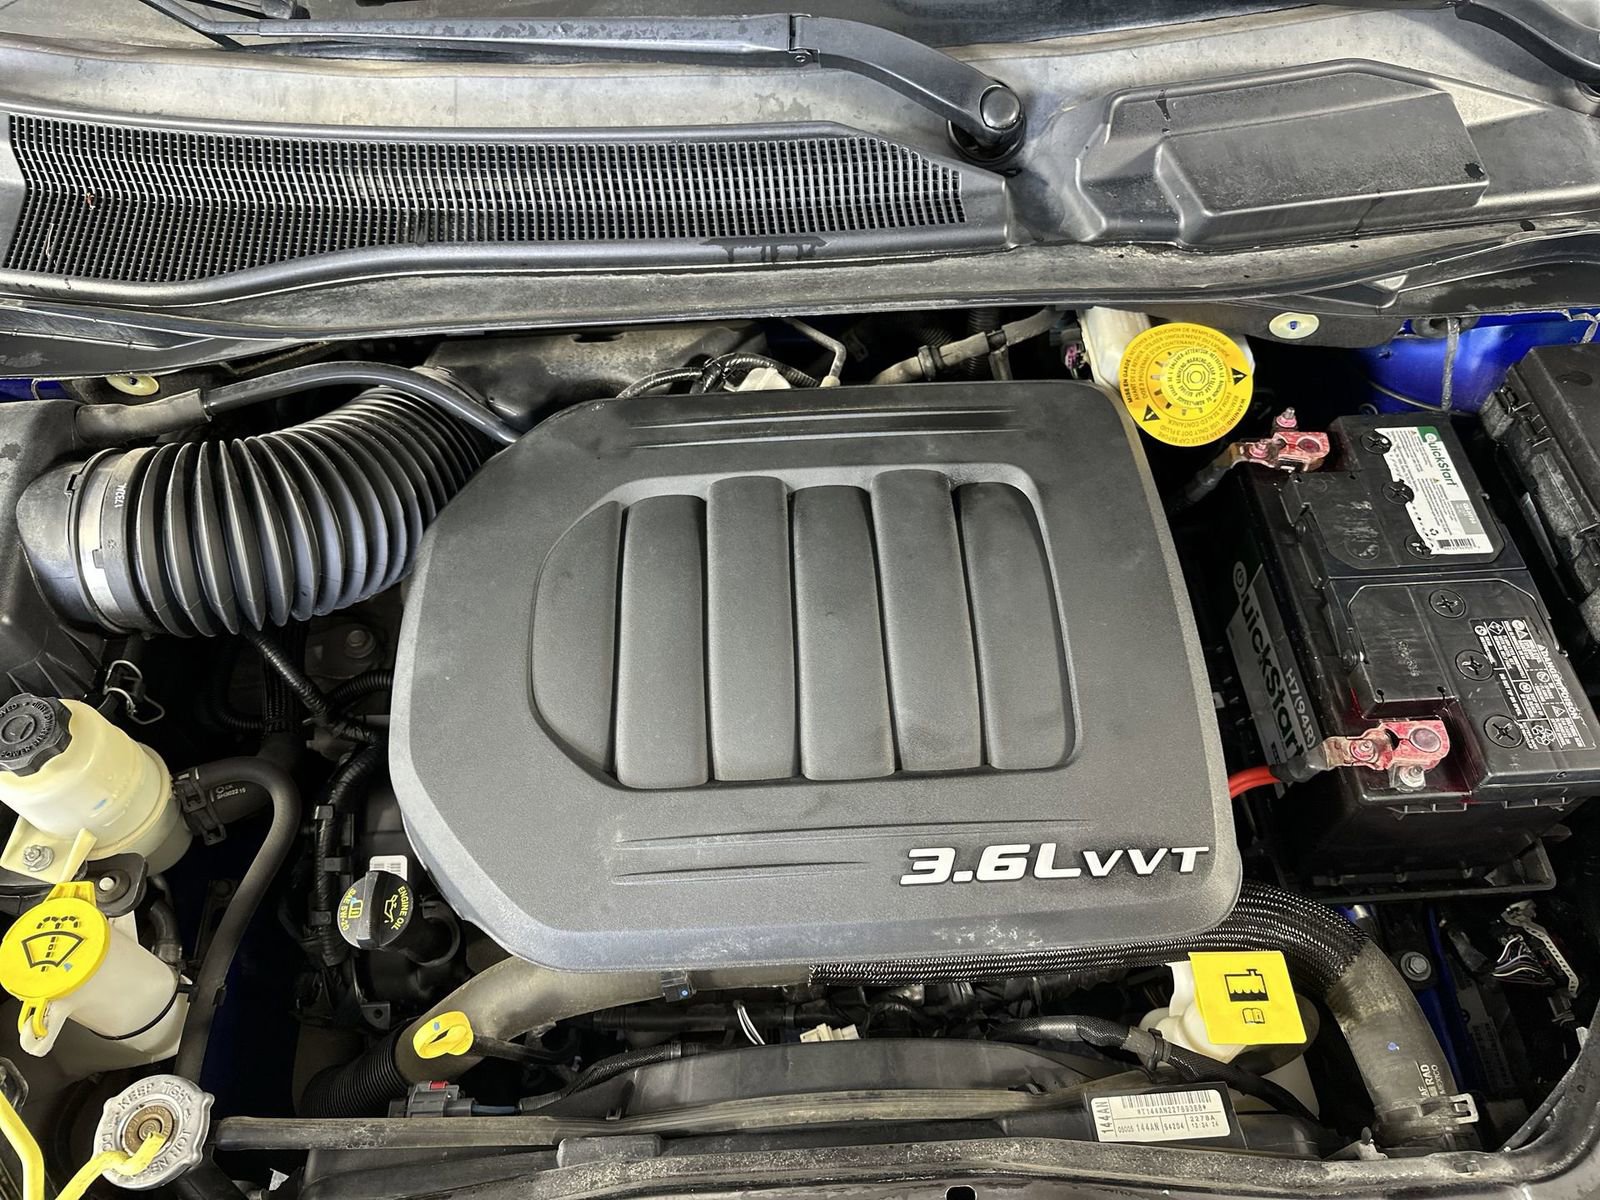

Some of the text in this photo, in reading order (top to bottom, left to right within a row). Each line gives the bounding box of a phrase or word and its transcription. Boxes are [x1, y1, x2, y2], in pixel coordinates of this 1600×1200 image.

[1425, 433, 1458, 486] QuickStart
[1233, 561, 1304, 758] QuickStart
[1285, 668, 1317, 748] H7(94R)
[391, 886, 409, 930] ENGINE OIL
[1421, 1065, 1434, 1086] RAD
[119, 1082, 155, 1110] KEEP
[1094, 1101, 1114, 1134] 144AN
[169, 1128, 191, 1157] HOT
